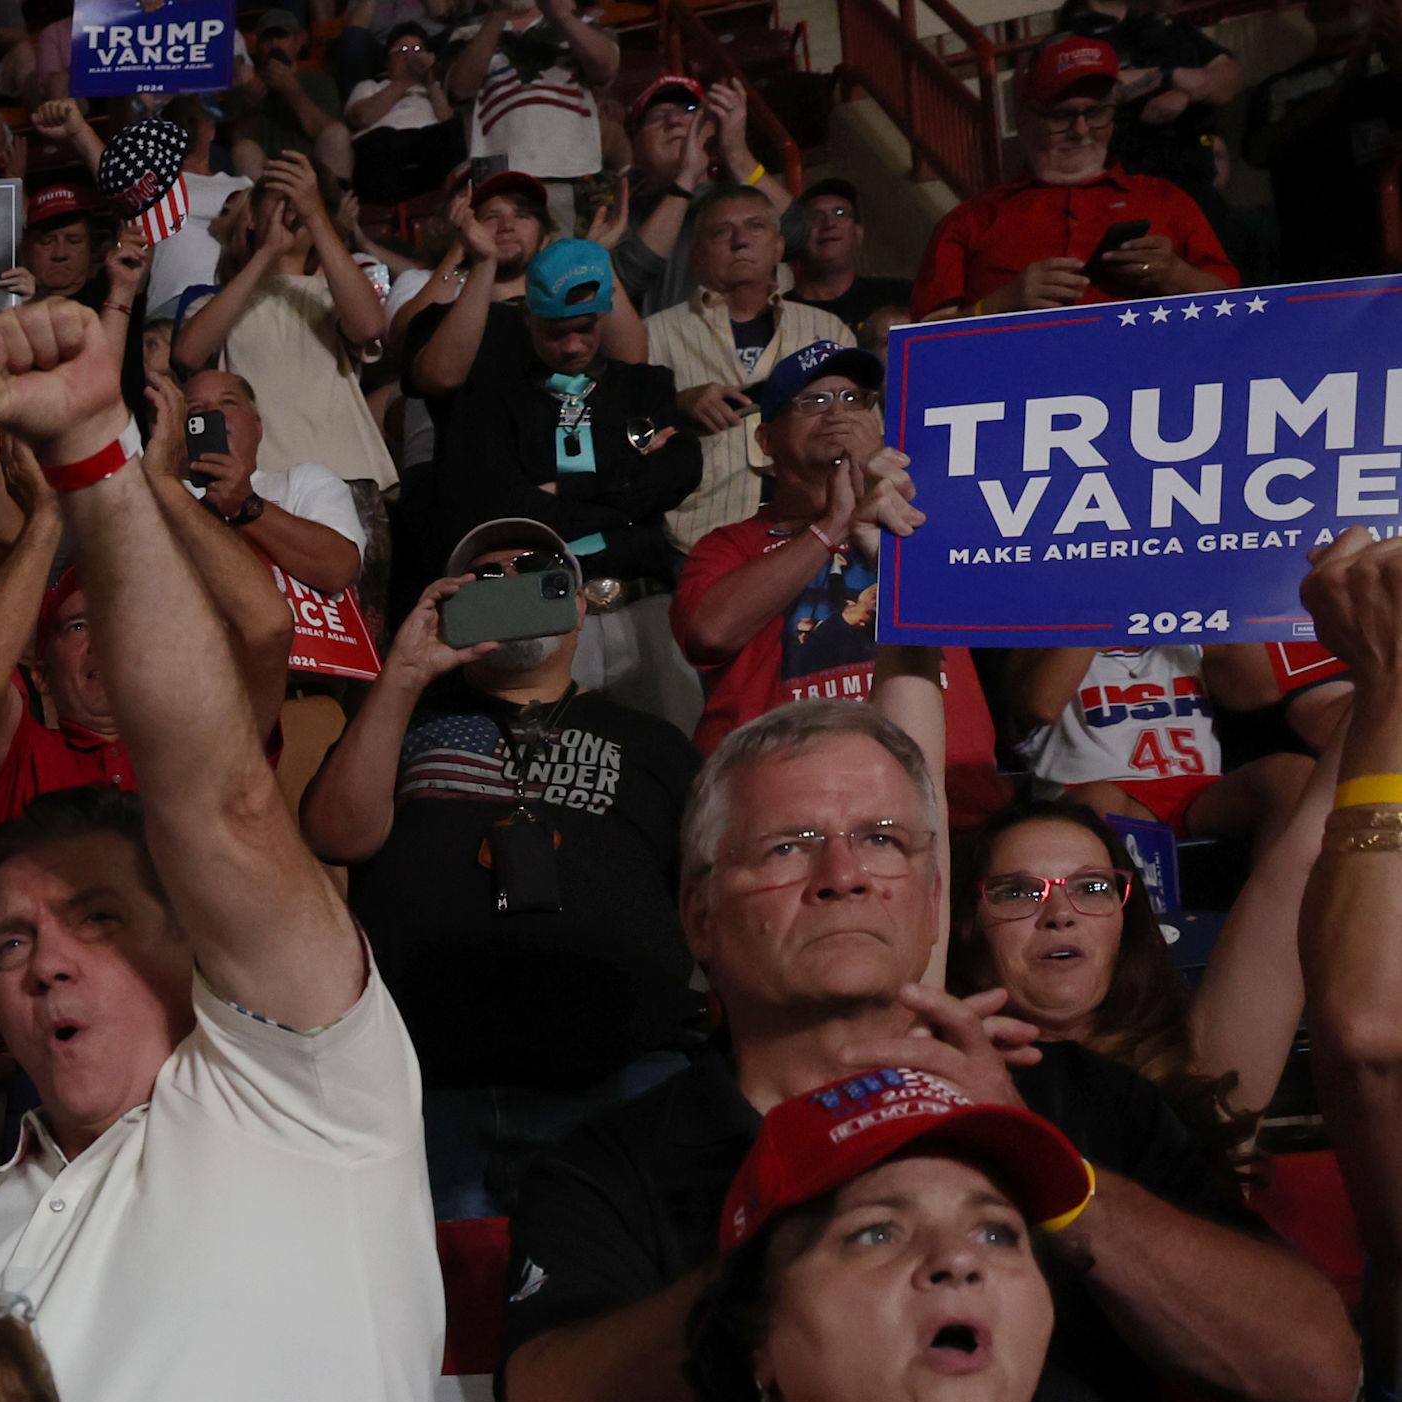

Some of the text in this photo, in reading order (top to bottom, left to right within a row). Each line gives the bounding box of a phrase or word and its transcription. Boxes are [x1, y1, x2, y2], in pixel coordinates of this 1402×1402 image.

[82, 19, 225, 50] TRUMP
[97, 44, 207, 66] VANCE
[923, 368, 1402, 477] TRUM
[978, 452, 1401, 539] VANCE
[948, 545, 1032, 566] MAKE
[1043, 536, 1185, 562] AMERICA
[1196, 528, 1301, 552] GREAT
[1127, 610, 1231, 635] 2024
[1080, 676, 1214, 728] USA
[560, 728, 622, 752] ONE
[1128, 728, 1210, 775] 45
[501, 763, 621, 794] UNDER
[543, 785, 614, 816] GOD
